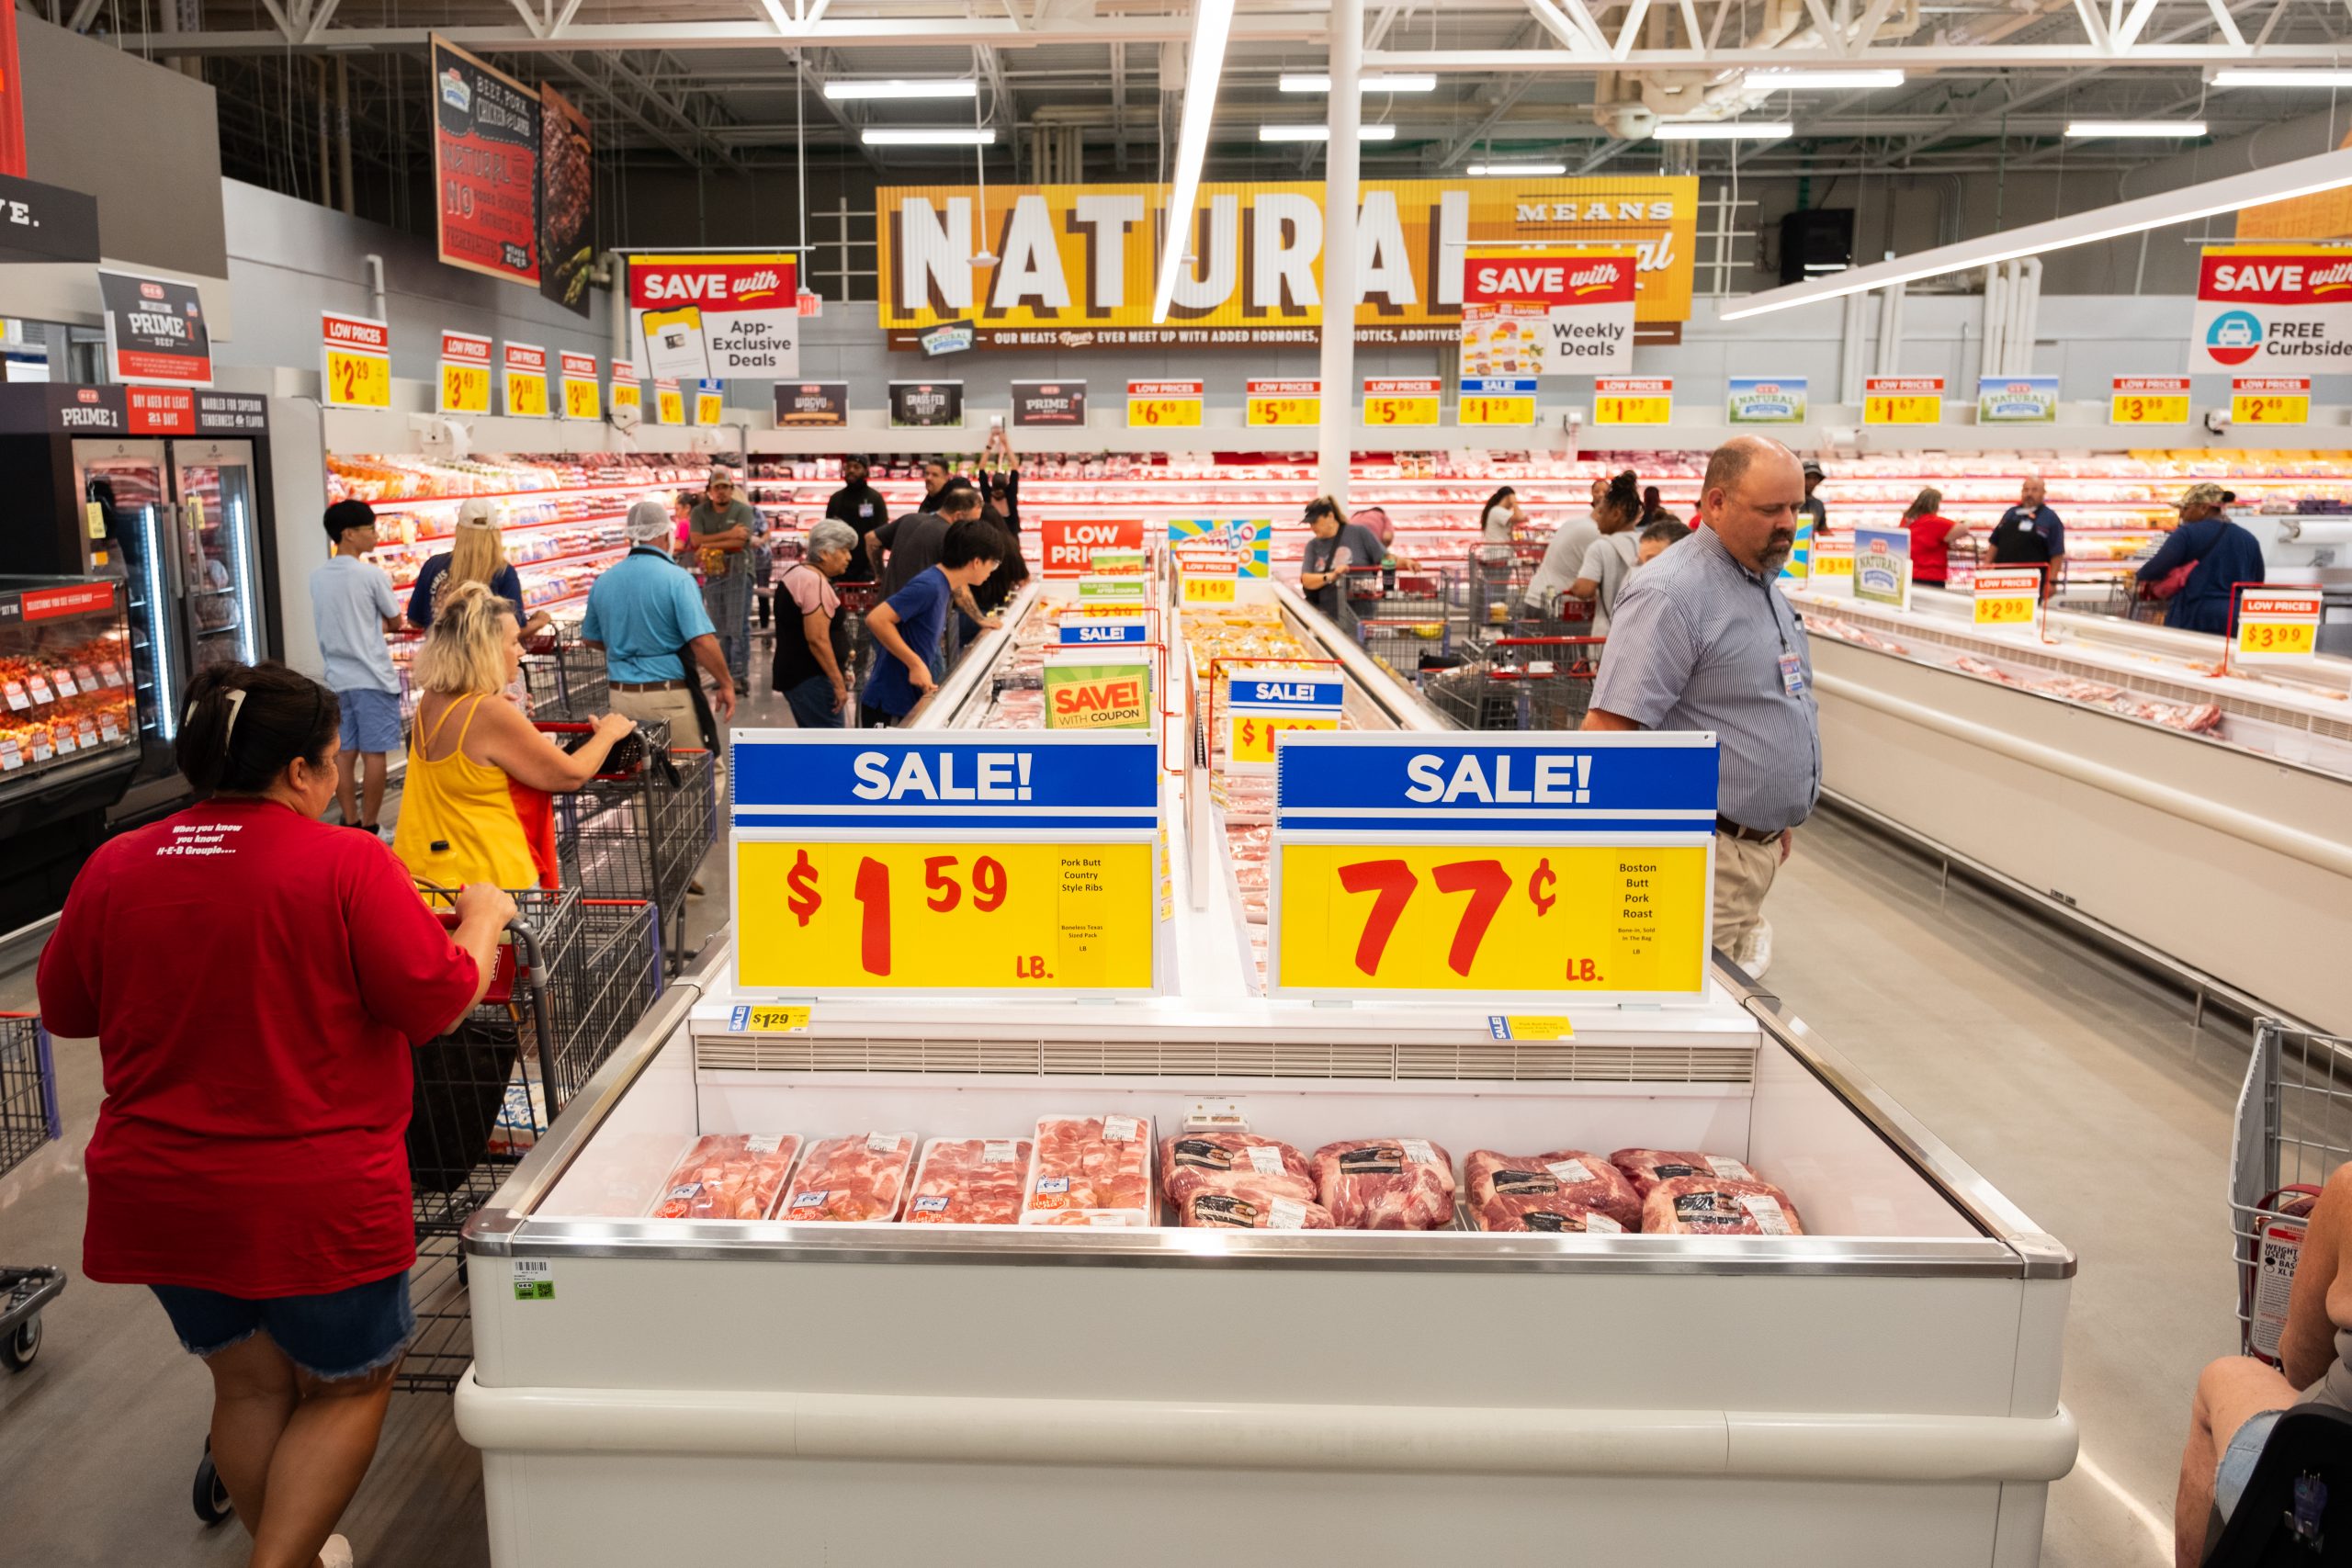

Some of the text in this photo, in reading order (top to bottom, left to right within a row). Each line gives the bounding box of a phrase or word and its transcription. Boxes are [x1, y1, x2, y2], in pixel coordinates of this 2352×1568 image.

[477, 97, 505, 126] CHICKEN
[446, 178, 475, 219] NO
[0, 199, 40, 227] E.
[1516, 202, 1674, 222] MEANS
[644, 270, 780, 299] SAVE with
[1477, 264, 1620, 293] SAVE with
[2213, 265, 2304, 292] SAVE
[128, 313, 186, 338] PRIME
[330, 321, 381, 344] LOW PRICES
[730, 321, 774, 335] App-
[1553, 323, 1625, 341] Weekly
[2268, 322, 2325, 338] FREE
[713, 337, 792, 351] Exclusive
[994, 332, 1017, 344] OUR
[1020, 332, 1057, 344] MEATS
[1097, 331, 1126, 343] EVER
[1128, 331, 1158, 343] MEET
[1159, 331, 1177, 343] UP
[1179, 331, 1209, 343] WITH
[1211, 331, 1250, 342] ADDED
[1252, 331, 1319, 344] HORMONES,
[448, 340, 487, 356] LOW PRICES
[1560, 342, 1615, 356] Deals
[2267, 341, 2352, 356] Curbside
[729, 354, 777, 367] Deals
[1136, 384, 1195, 393] LOW PRICES
[1255, 382, 1314, 392] LOW PRICES
[1372, 381, 1431, 391] LOW PRICES
[1482, 381, 1516, 391] SALE!
[1603, 381, 1664, 391] LOW PRICES
[1873, 380, 1935, 389] LOW PRICES
[2120, 380, 2182, 389] LOW PRICES
[2240, 380, 2301, 389] LOW PRICES
[147, 395, 163, 408] AGED
[164, 396, 171, 409] AT
[172, 396, 189, 410] LEAST
[201, 398, 262, 412] MARBLED FOR SUPERIOR
[1025, 398, 1069, 411] PRIME
[62, 408, 109, 427] PRIME
[148, 412, 178, 426] 21 DAYS
[201, 413, 234, 427] TENDERNESS
[1064, 525, 1119, 544] LOW
[1205, 563, 1232, 571] PRICES
[1859, 555, 1898, 574] NATURAL
[1979, 579, 2032, 588] LOW PRICES
[2248, 602, 2312, 611] LOW PRICES
[1080, 626, 1125, 641] SALE!
[1055, 682, 1139, 714] SAVE!
[1255, 683, 1316, 701] SALE!
[1058, 709, 1139, 726] WITH COUPON
[852, 751, 1033, 801] SALE!
[1404, 754, 1592, 804] SALE!
[173, 823, 243, 833] When you know
[175, 834, 224, 844] you know!
[156, 846, 184, 855] H-E-B
[1620, 863, 1657, 873] Boston
[1064, 872, 1098, 880] Country
[1626, 878, 1648, 888] Butt
[1062, 884, 1083, 893] Style
[1624, 894, 1649, 903] Pork
[1623, 909, 1653, 919] Roast
[1016, 955, 1054, 979] LB.
[1566, 958, 1604, 981] LB.
[732, 1006, 747, 1030] SALE!
[2265, 1243, 2299, 1256] WEIGHT
[2265, 1249, 2286, 1259] USER
[2278, 1268, 2288, 1276] XL
